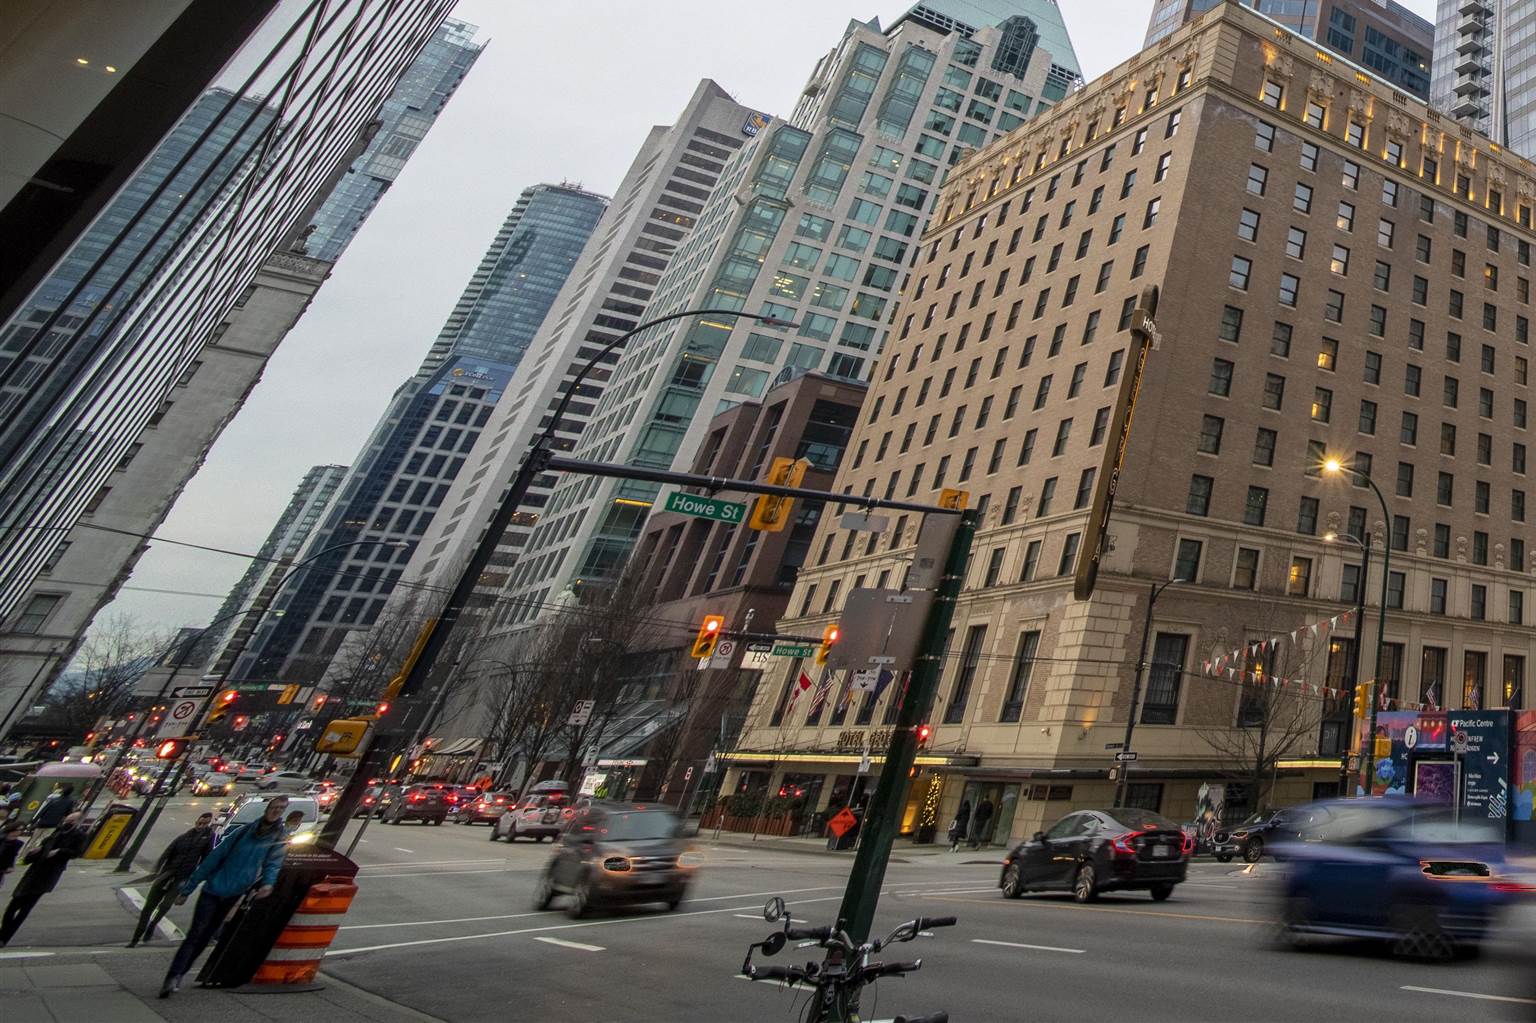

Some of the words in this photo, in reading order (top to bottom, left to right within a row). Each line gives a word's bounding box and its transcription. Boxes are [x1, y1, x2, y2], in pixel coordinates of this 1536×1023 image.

[672, 496, 715, 515] Howe
[721, 504, 739, 519] St
[775, 646, 800, 656] Howe
[803, 648, 812, 657] St
[1460, 719, 1476, 728] Pacific
[1476, 719, 1494, 728] Centre
